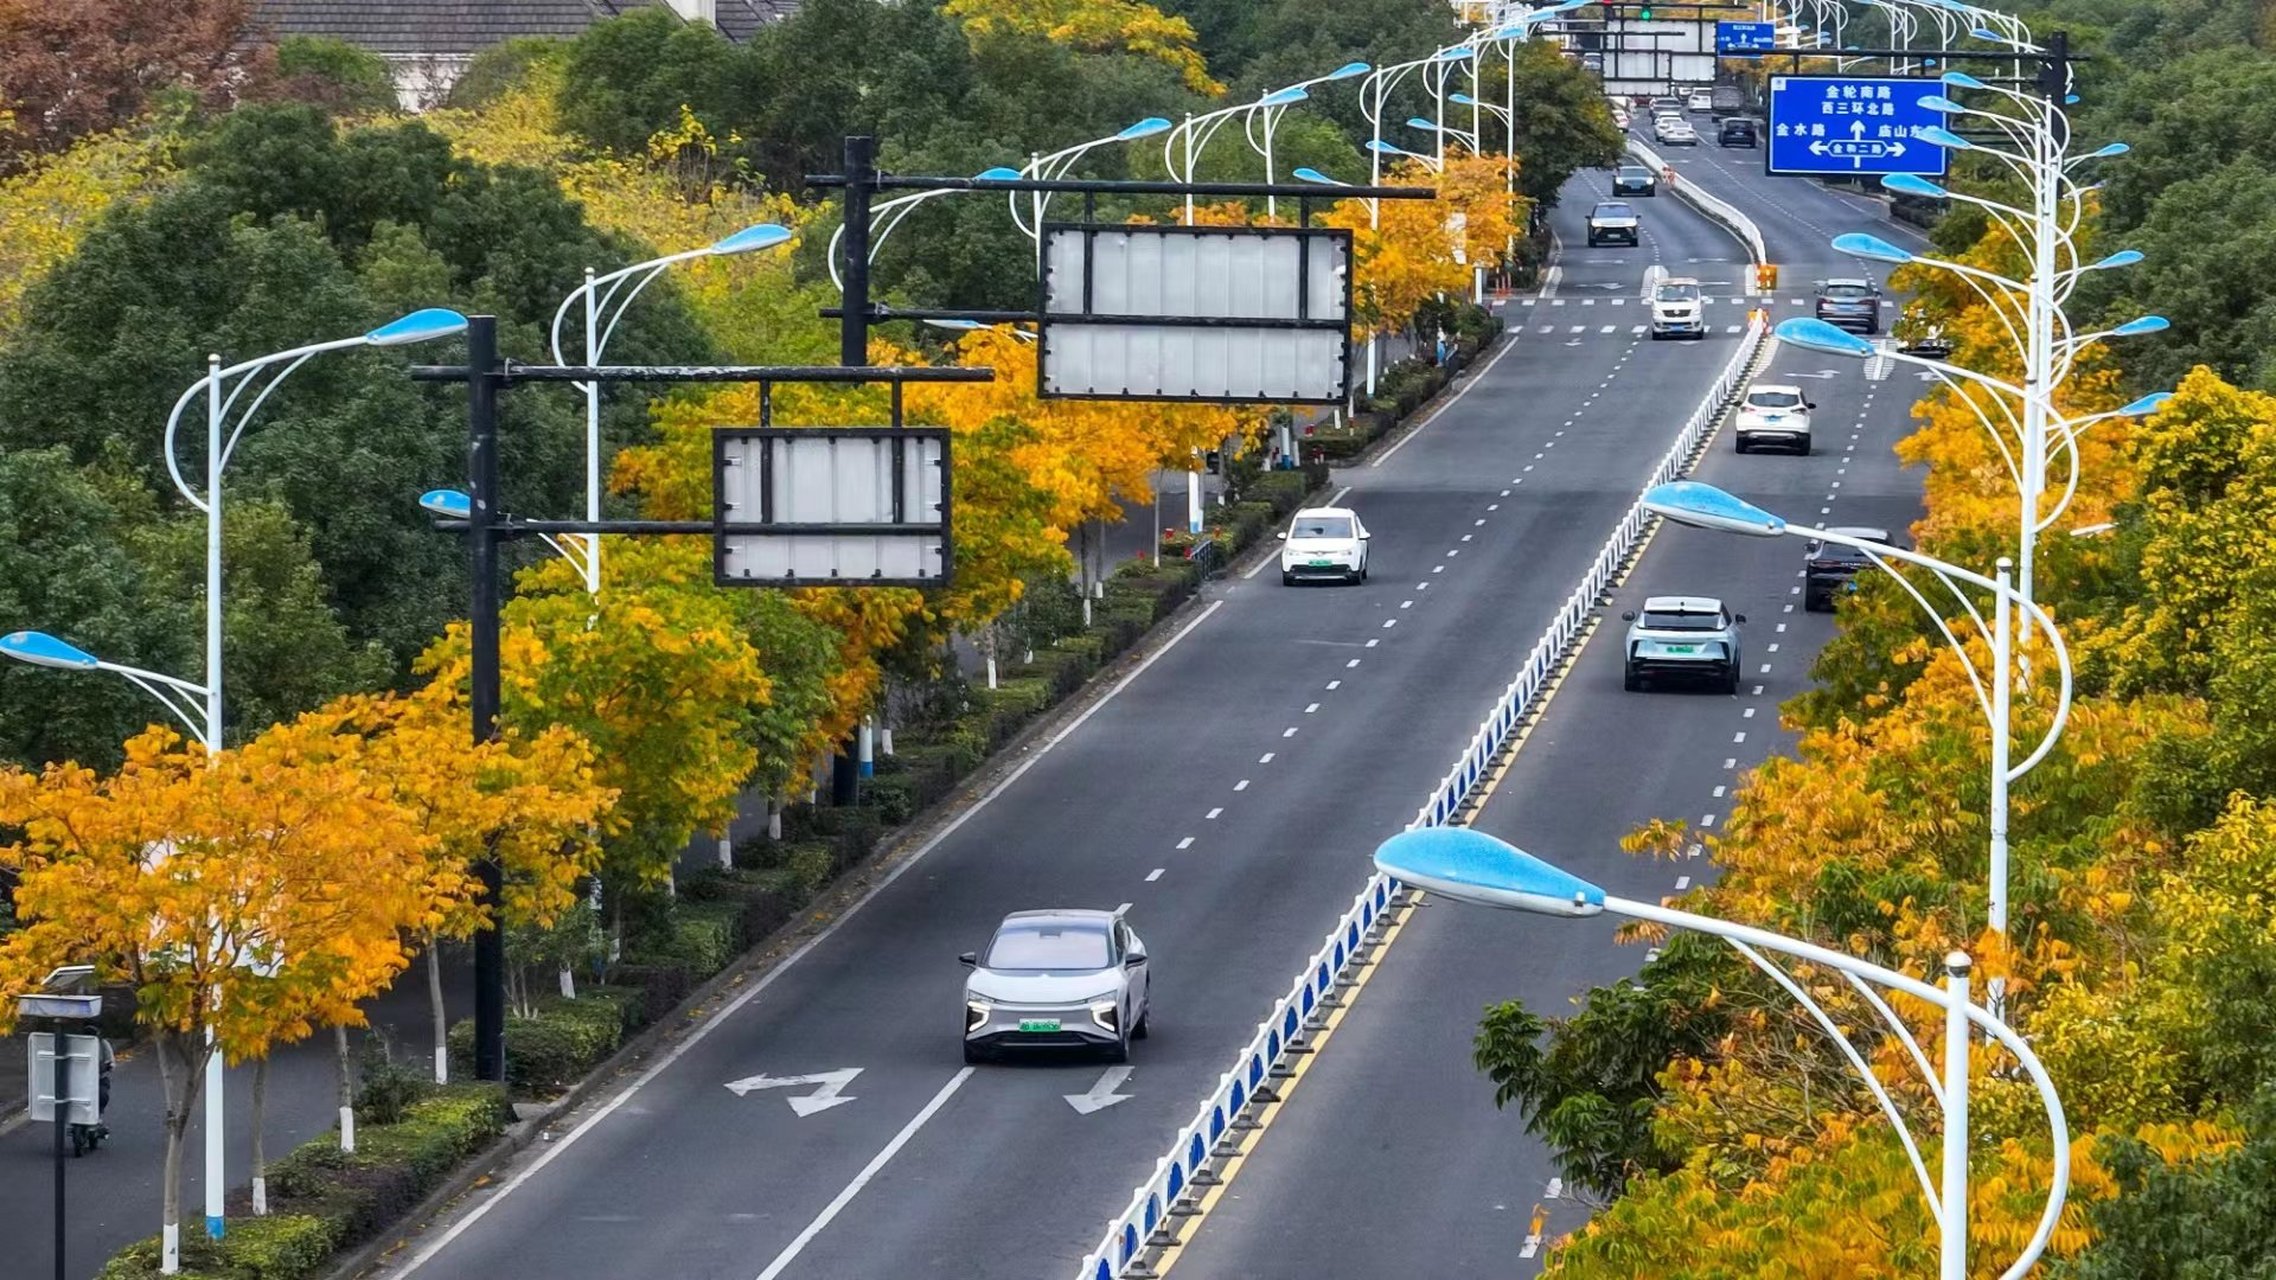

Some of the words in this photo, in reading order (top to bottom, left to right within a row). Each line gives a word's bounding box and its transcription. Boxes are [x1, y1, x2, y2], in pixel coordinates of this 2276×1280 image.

[1826, 84, 1891, 100] 金轮南路
[1821, 101, 1895, 116] 西三环北路
